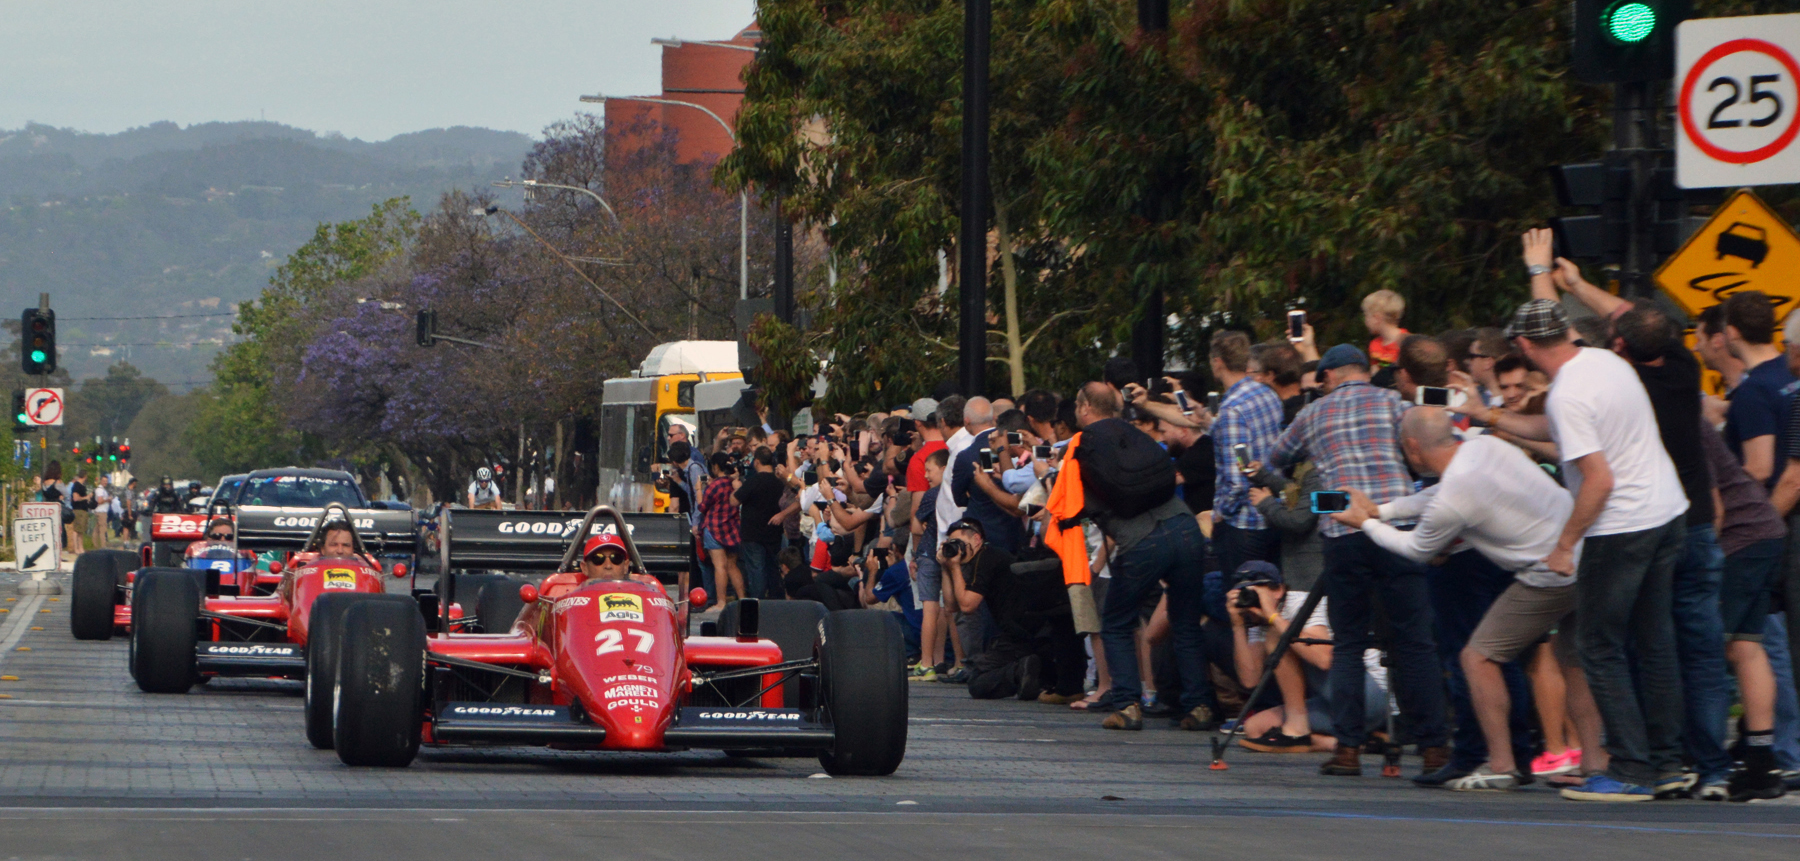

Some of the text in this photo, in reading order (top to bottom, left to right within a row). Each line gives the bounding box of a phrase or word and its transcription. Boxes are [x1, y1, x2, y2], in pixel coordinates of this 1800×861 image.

[1706, 73, 1783, 130] 25
[26, 507, 55, 517] STOP
[20, 523, 46, 532] KEEP
[22, 533, 46, 543] LEFT
[605, 610, 640, 621] Agip
[595, 628, 655, 656] 27
[208, 645, 293, 655] GOODYEAR
[633, 664, 654, 674] 79
[603, 674, 658, 684] WEBER
[607, 698, 659, 710] GOULD
[454, 706, 556, 716] GOODYEAR
[699, 711, 800, 720] GOODYEAR
